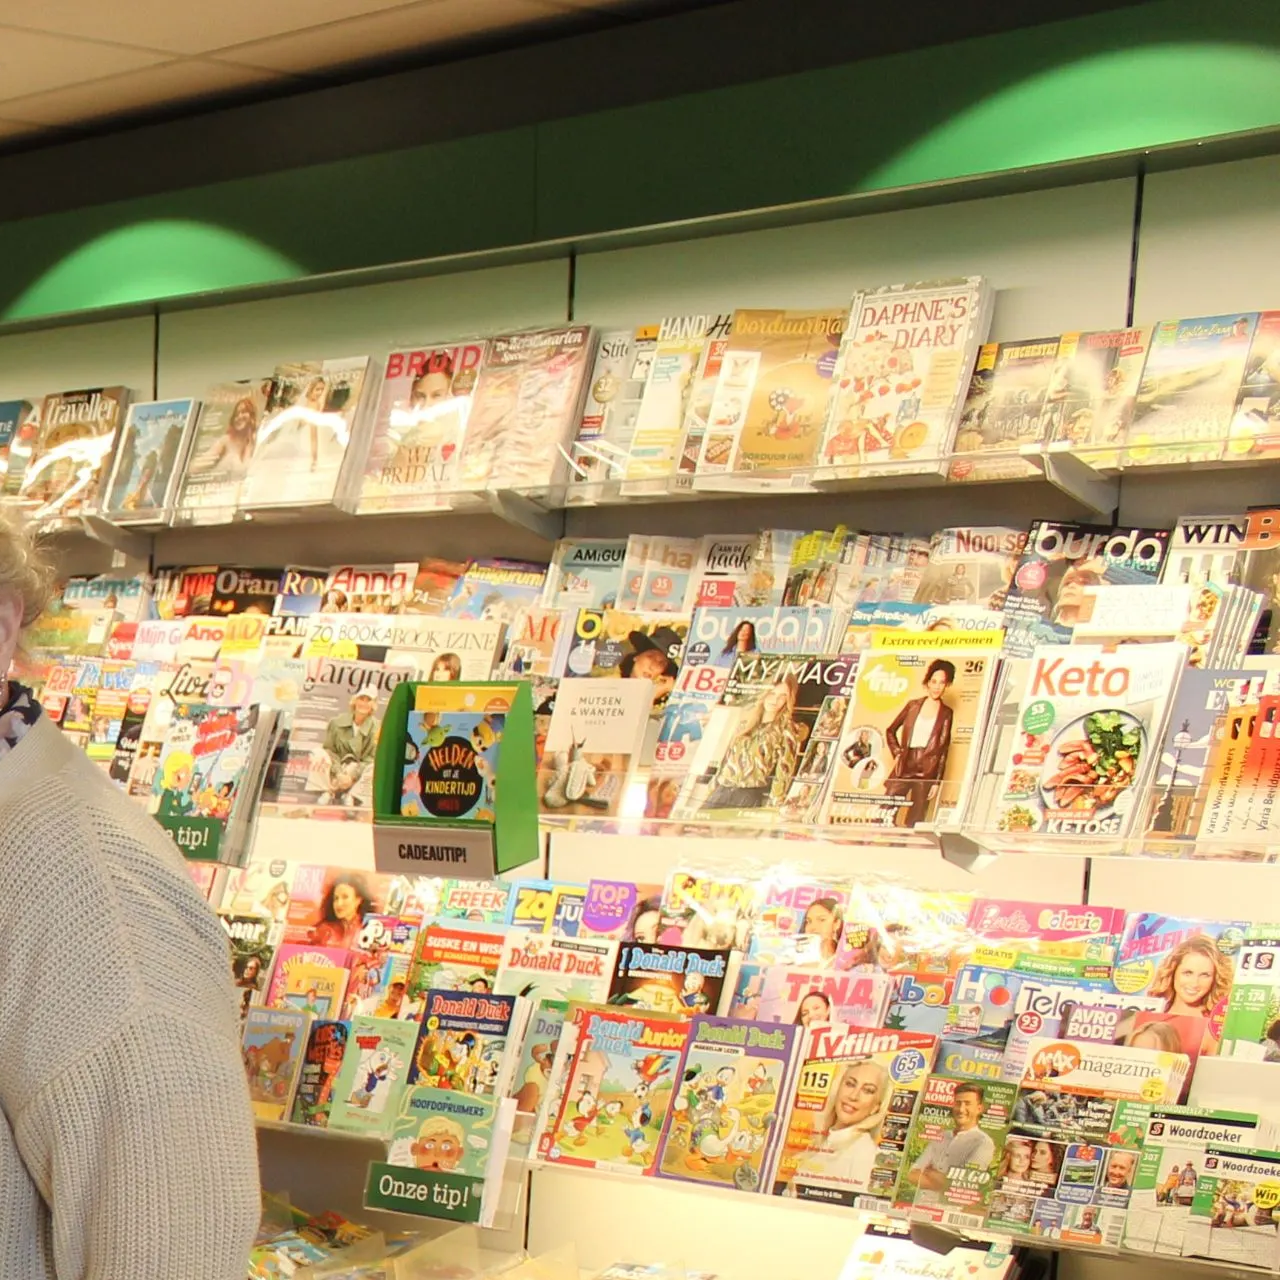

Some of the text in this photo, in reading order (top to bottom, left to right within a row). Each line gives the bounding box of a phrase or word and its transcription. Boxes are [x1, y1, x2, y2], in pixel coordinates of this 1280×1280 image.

[858, 296, 968, 330] DAPHNE'S
[892, 321, 964, 351] DIARY
[386, 349, 481, 380] BRUID
[46, 396, 116, 427] Traveller
[379, 463, 451, 485] BRIDAL
[331, 566, 407, 594] Anna
[701, 581, 718, 597] 18
[881, 635, 910, 647] Extra
[939, 635, 994, 649] patronen
[963, 659, 985, 674] 26
[1031, 657, 1130, 698] Keto
[577, 706, 626, 718] WANTEN
[578, 696, 623, 707] MUTSEN
[429, 744, 476, 772] HELDEN
[425, 780, 477, 796] KINDERTIJD
[177, 826, 210, 850] tip!
[398, 843, 468, 864] CADEAUTIP!
[447, 889, 508, 912] FREEK
[591, 883, 630, 905] TOP
[425, 935, 478, 953] SUSKE EN
[508, 948, 605, 977] Donald Duck
[629, 949, 725, 978] Donald Duck
[431, 995, 509, 1021] Donald Duck
[1071, 1007, 1118, 1024] AVRO
[588, 1016, 688, 1048] Donald Junior
[1019, 1014, 1039, 1029] 93
[1065, 1023, 1115, 1041] BODE
[749, 1027, 786, 1050] Duck
[897, 1055, 919, 1073] 65
[1079, 1056, 1162, 1081] magazine
[803, 1072, 829, 1089] 115
[410, 1099, 486, 1118] HOOFDOPRUIMERS
[923, 1106, 951, 1117] DOLLY
[1169, 1125, 1243, 1144] Woordzoeker
[378, 1174, 470, 1210] Onze tip!
[1255, 1186, 1279, 1202] Win
